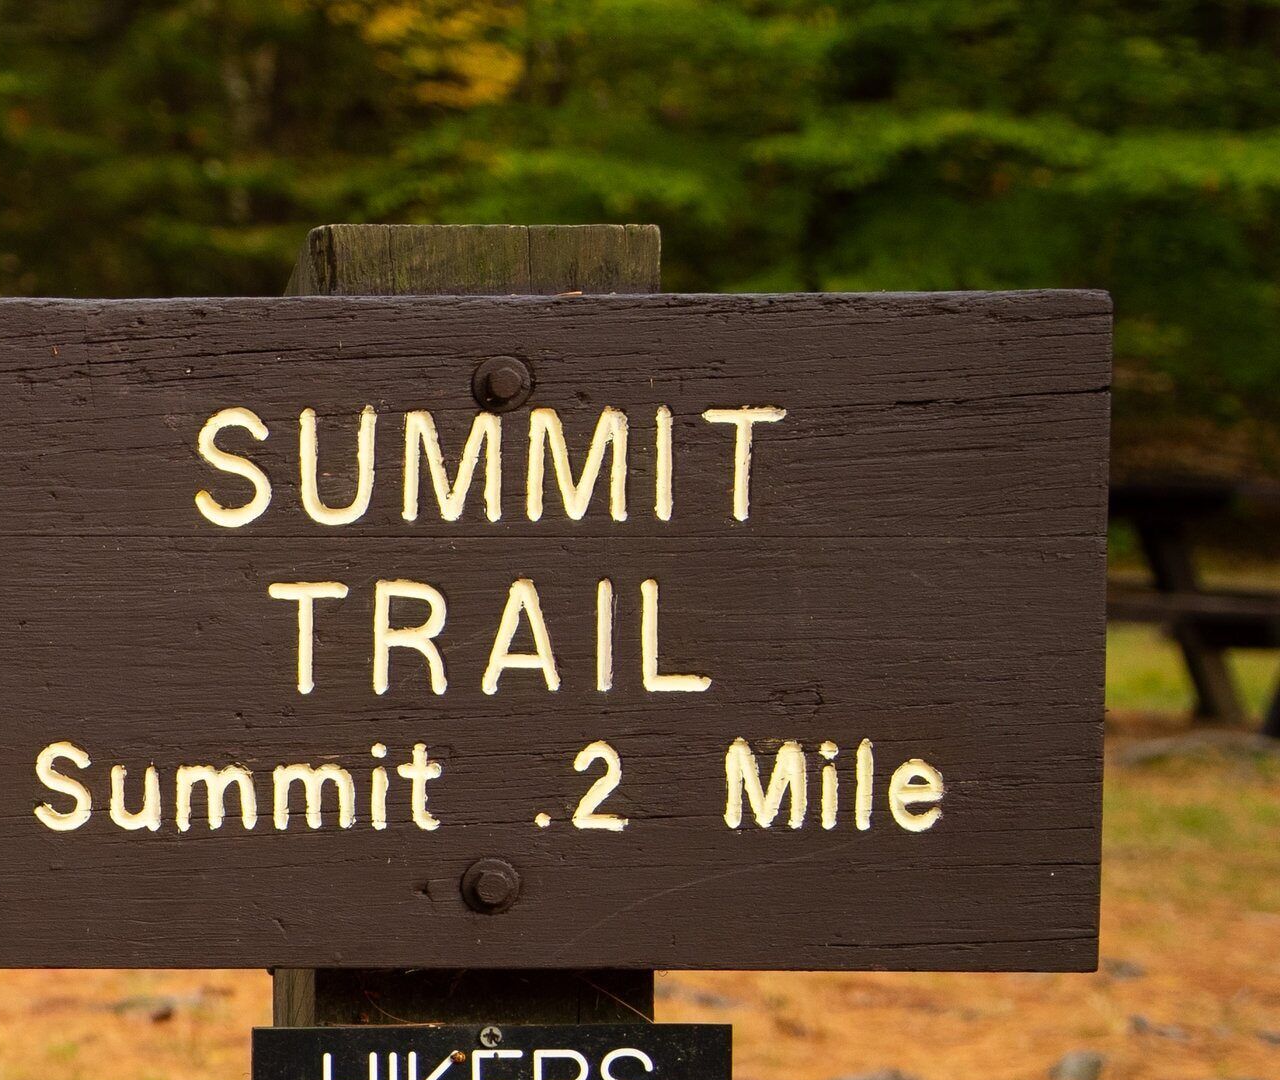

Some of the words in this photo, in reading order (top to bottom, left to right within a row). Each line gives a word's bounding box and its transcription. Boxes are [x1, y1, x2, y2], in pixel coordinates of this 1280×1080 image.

[194, 404, 787, 528] SUMMIT
[268, 578, 713, 696] TRAIL
[33, 741, 442, 834] Summit
[534, 739, 629, 832] .2
[723, 736, 945, 833] Mile
